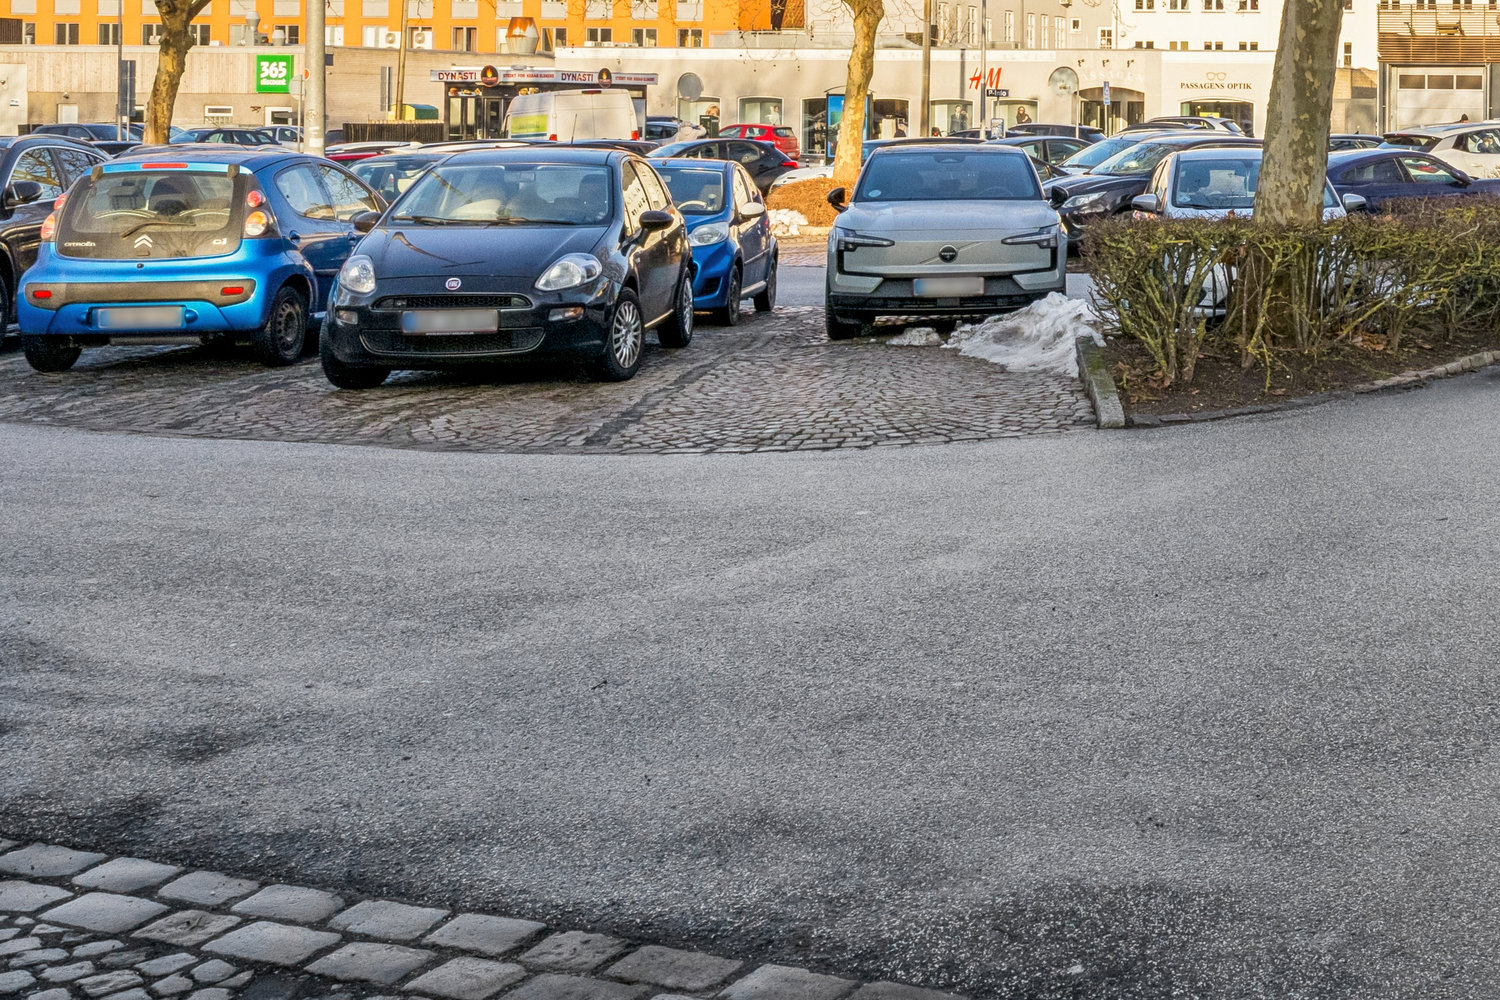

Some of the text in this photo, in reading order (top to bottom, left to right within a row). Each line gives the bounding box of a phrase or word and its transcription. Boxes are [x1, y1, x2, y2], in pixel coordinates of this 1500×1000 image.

[260, 61, 287, 79] 365
[438, 72, 477, 81] DYNASTI
[561, 73, 594, 82] DYNASTI
[1180, 82, 1252, 90] PASSAGENS OPTIK
